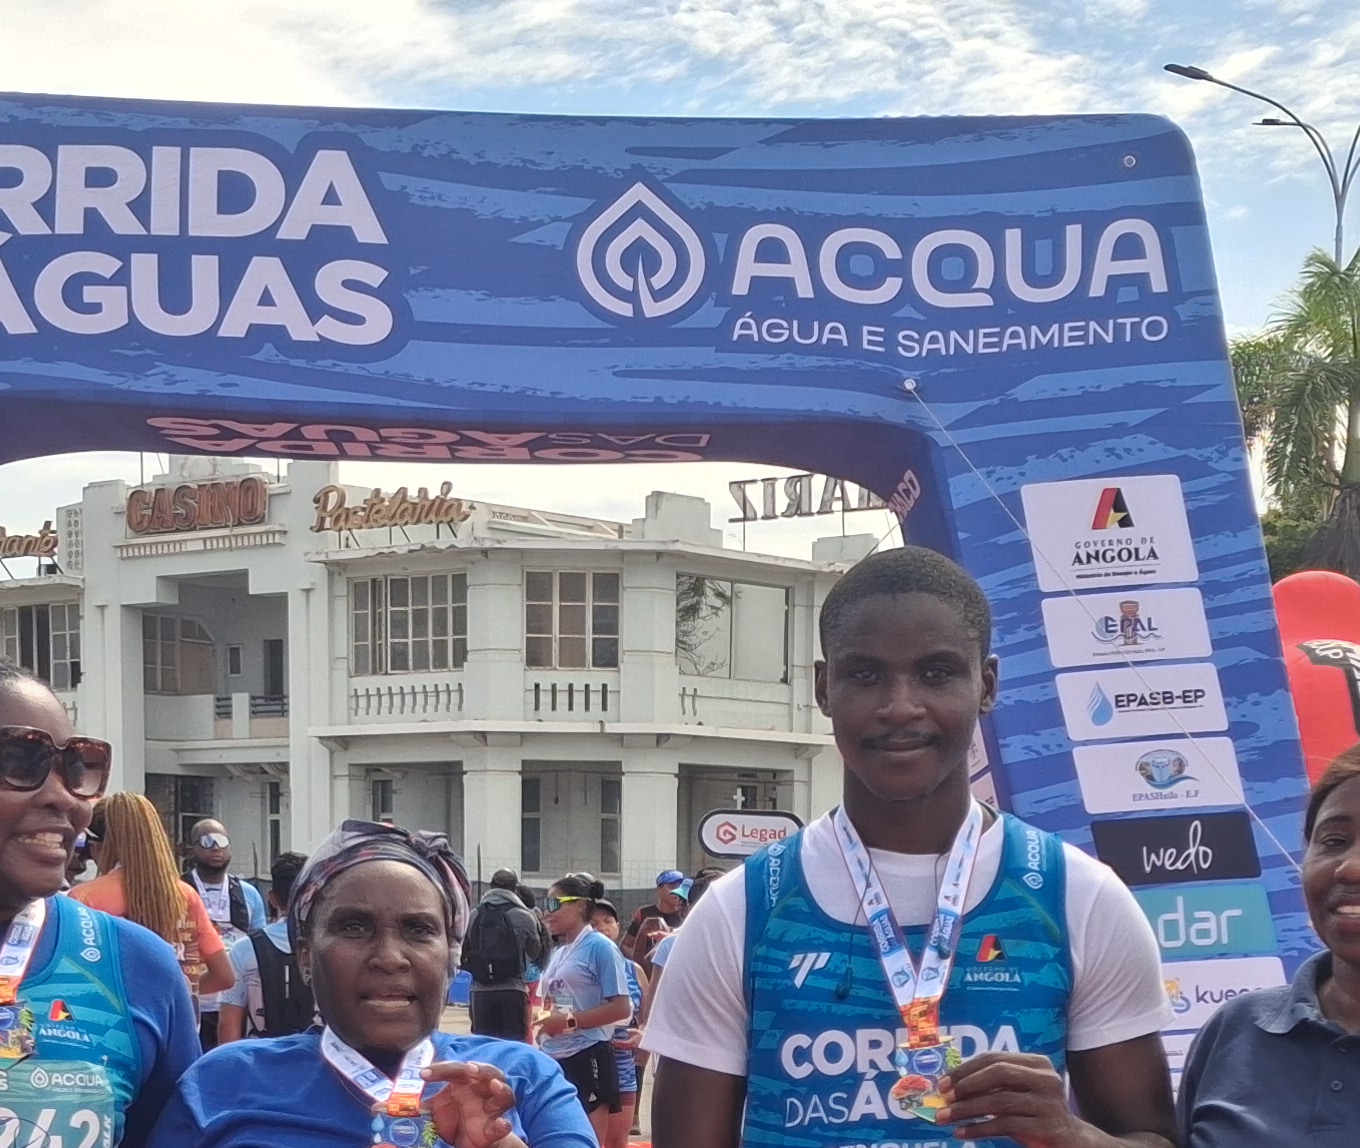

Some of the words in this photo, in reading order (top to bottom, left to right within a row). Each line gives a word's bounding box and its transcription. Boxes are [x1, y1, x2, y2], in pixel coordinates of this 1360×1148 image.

[731, 218, 1169, 308] ACQUA
[732, 311, 848, 346] ÁGUA
[862, 326, 885, 353] E
[897, 315, 1169, 358] SANEAMENTO
[126, 476, 267, 536] CASINO
[1071, 545, 1159, 567] ANGOLA
[1074, 537, 1133, 550] GOVERNO
[1140, 536, 1155, 546] DE
[1113, 688, 1206, 710] EPASB-EP
[1026, 830, 1041, 871] ACQUA
[1142, 820, 1213, 874] wedo
[1157, 896, 1243, 949] dar
[963, 972, 1022, 984] ANGOLA
[38, 1027, 91, 1043] ANGOLA
[51, 1073, 109, 1087] ACQUA
